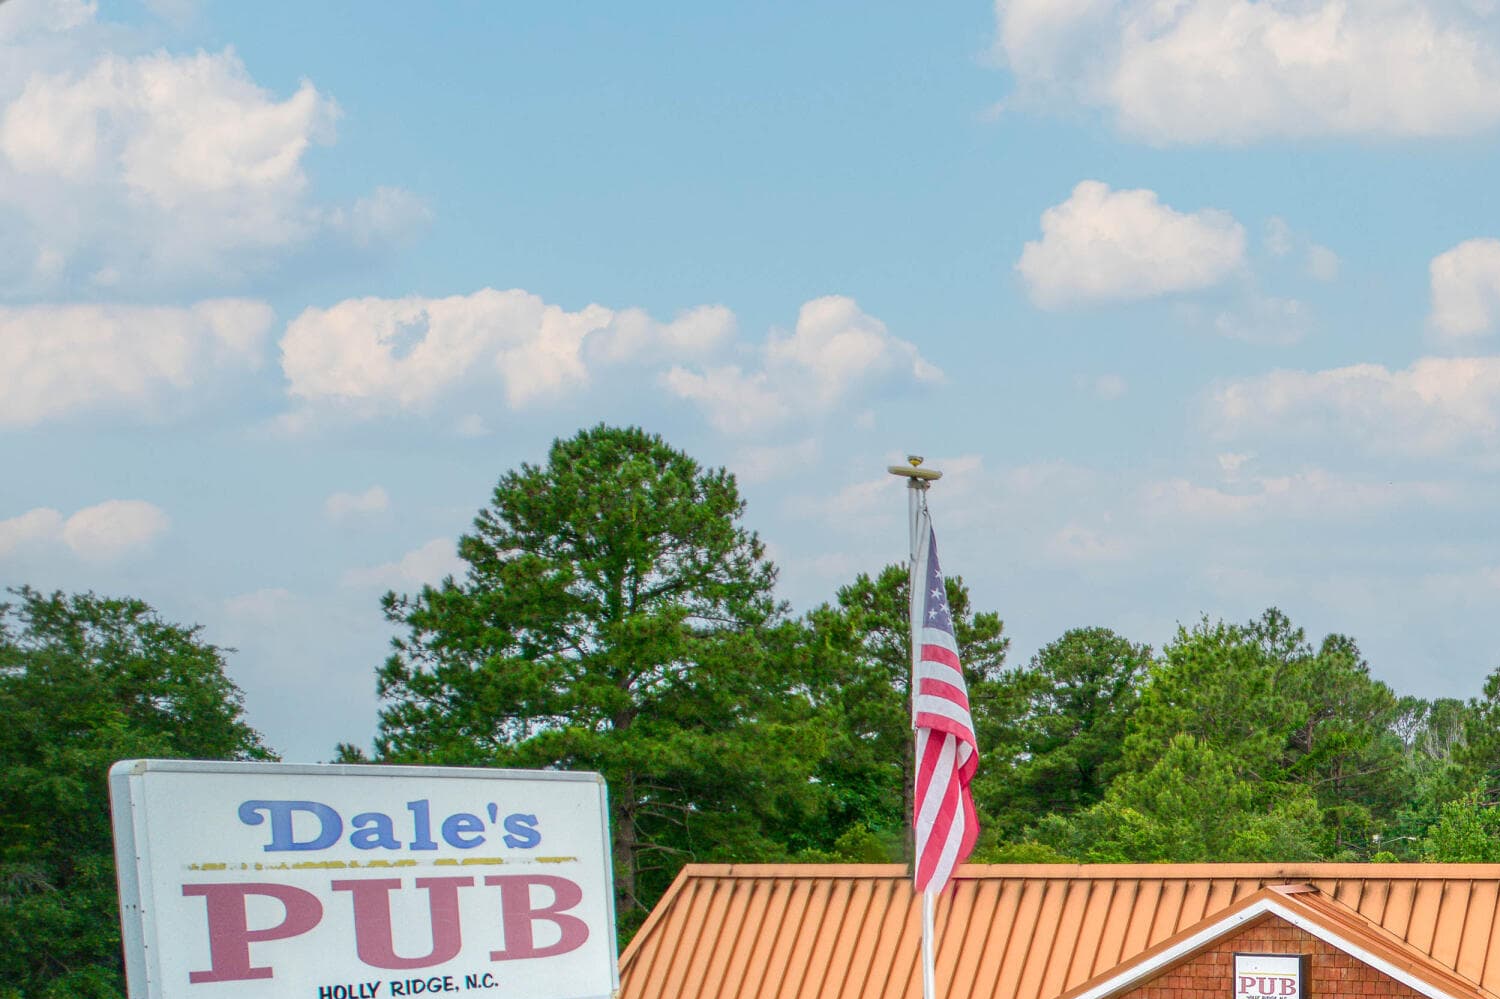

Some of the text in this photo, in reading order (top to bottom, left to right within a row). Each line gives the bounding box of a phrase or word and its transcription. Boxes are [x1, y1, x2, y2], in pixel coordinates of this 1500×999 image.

[238, 798, 542, 852] Dale's
[181, 873, 590, 984] PUB
[390, 976, 459, 997] RIDGE,
[465, 973, 499, 990] N.C.
[1238, 975, 1297, 996] PUB
